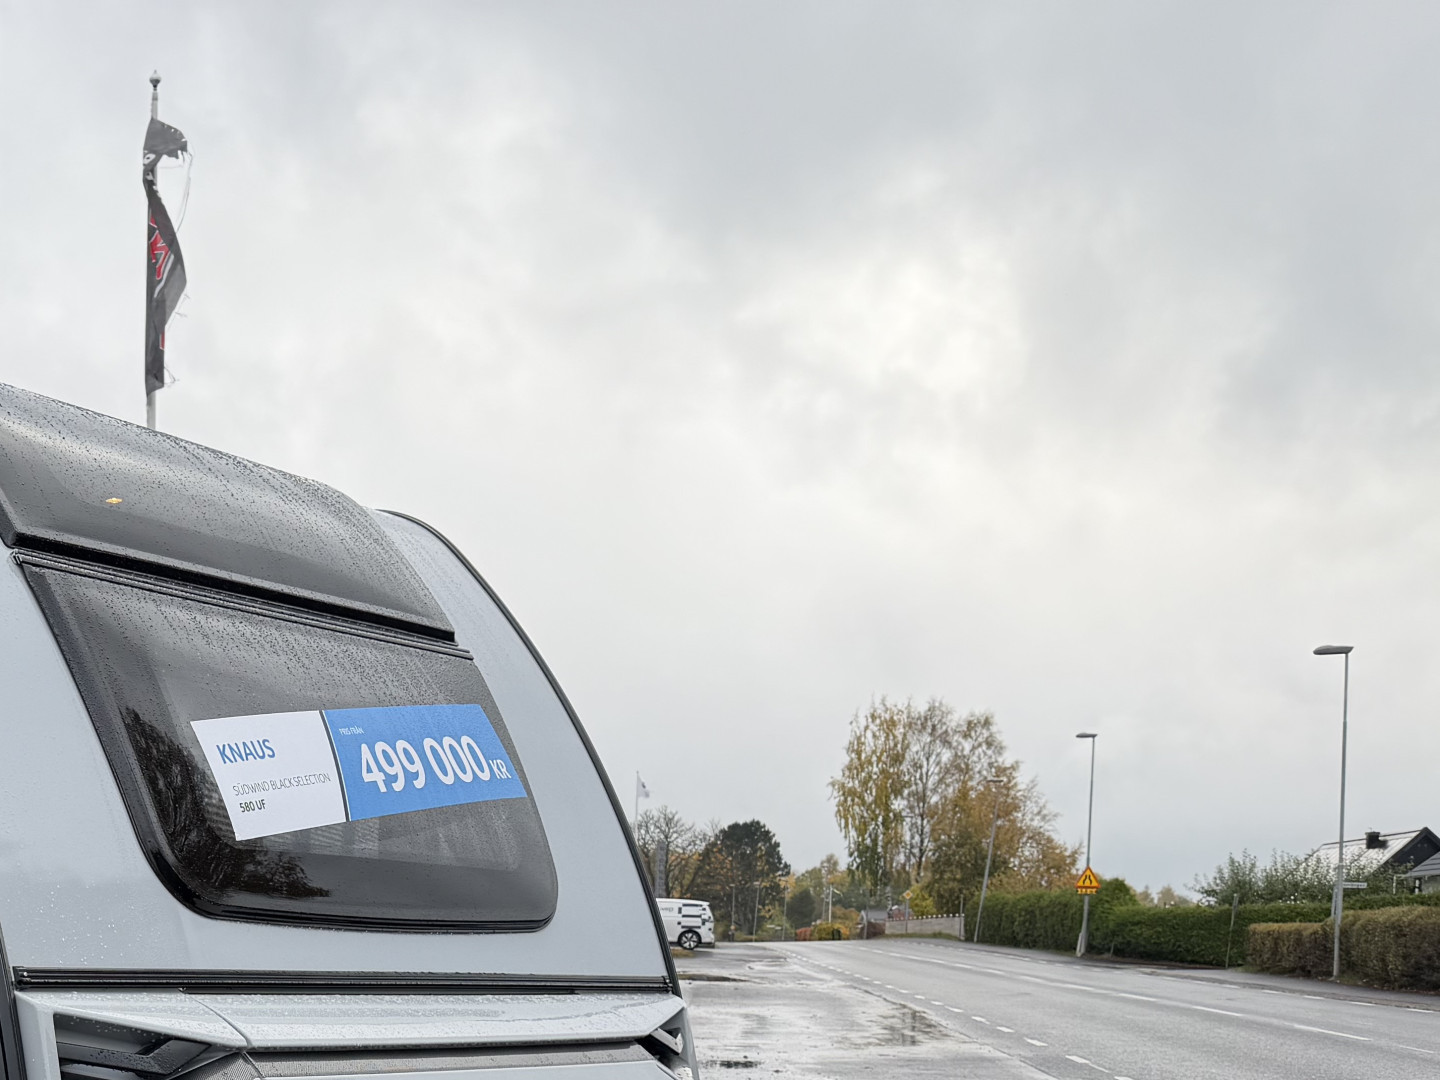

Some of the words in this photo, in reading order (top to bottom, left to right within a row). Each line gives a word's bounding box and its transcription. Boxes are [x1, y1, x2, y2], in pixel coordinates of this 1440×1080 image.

[216, 738, 276, 764] KNAUS
[361, 740, 426, 793] 499
[423, 735, 491, 785] 000
[489, 759, 511, 779] KR
[232, 782, 270, 797] SÜDWIND
[270, 777, 295, 791] BLACK
[293, 773, 332, 787] SELECTION
[239, 801, 256, 813] 580
[255, 799, 266, 811] UF
